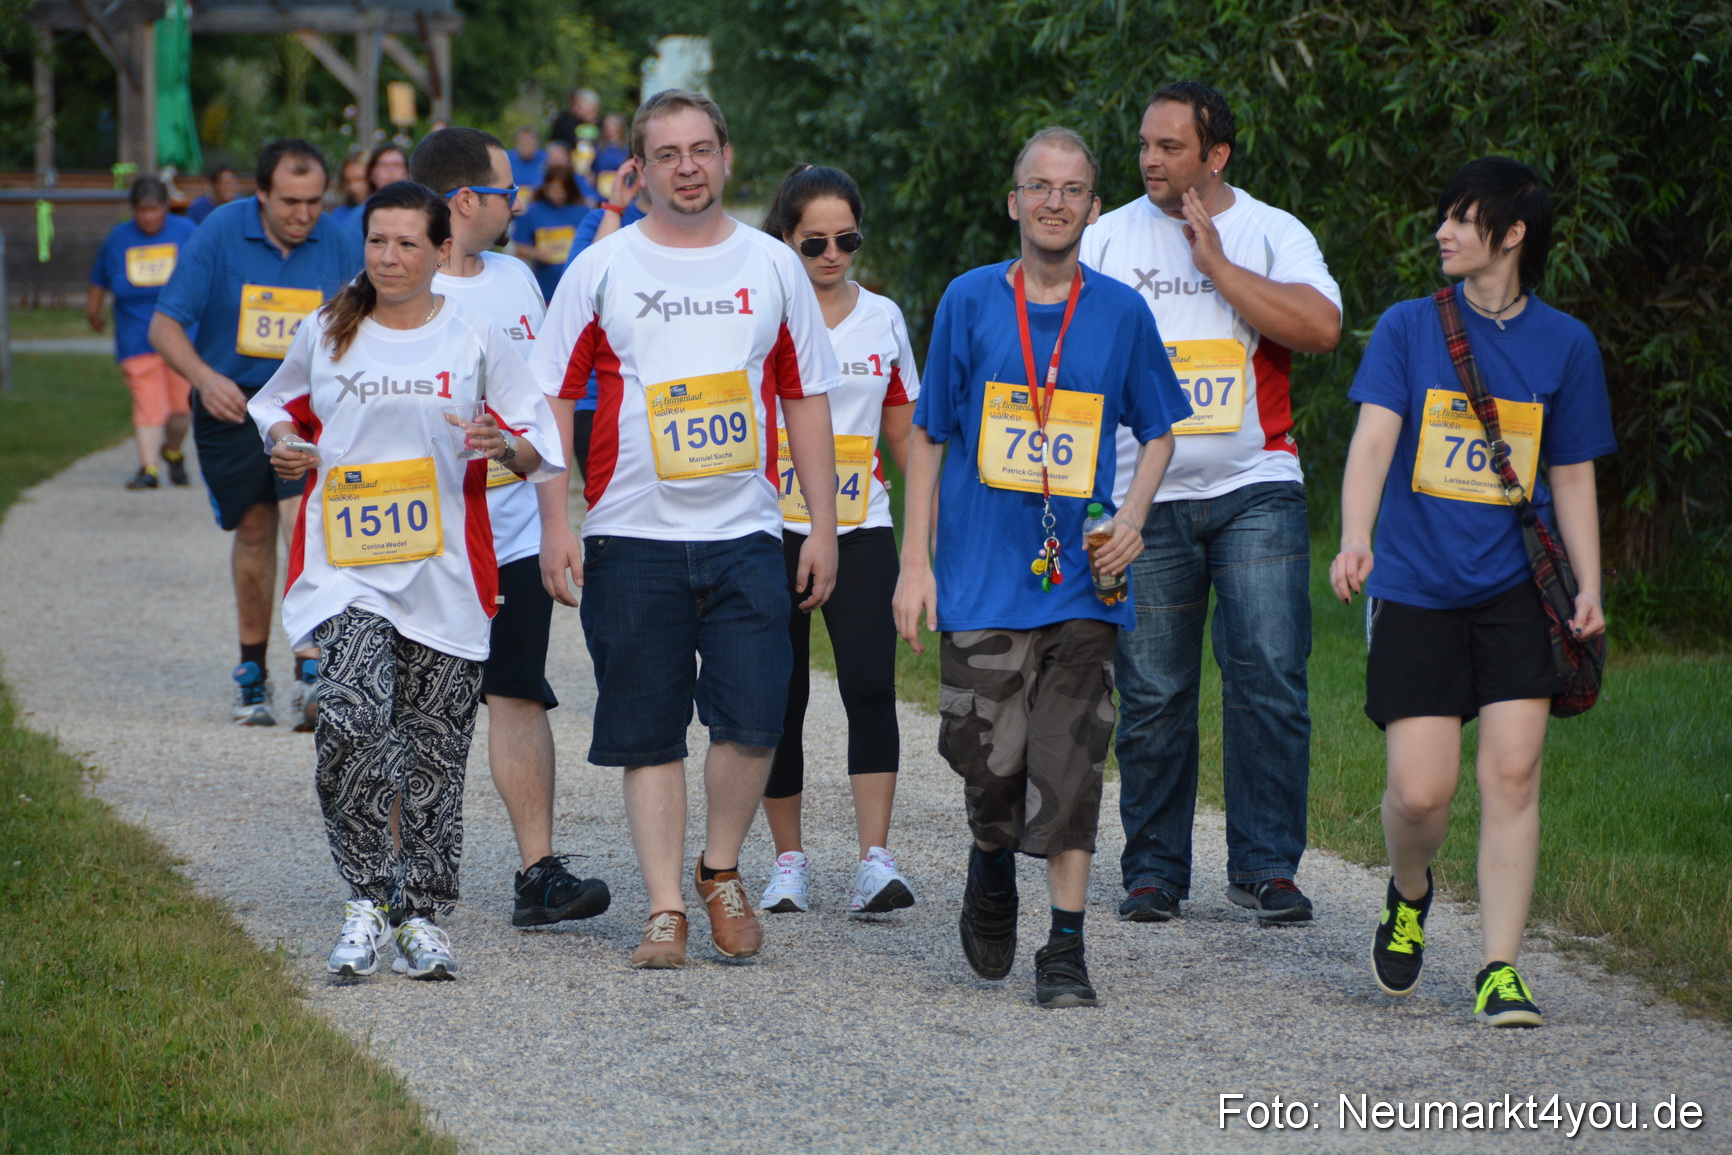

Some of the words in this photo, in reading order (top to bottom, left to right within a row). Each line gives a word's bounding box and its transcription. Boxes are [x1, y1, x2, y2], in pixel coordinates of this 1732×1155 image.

[1132, 268, 1217, 300] Xplus
[633, 287, 753, 322] Xplus1
[334, 370, 452, 404] Xplus1
[663, 411, 747, 452] 1509
[1005, 427, 1074, 466] 796
[689, 454, 713, 463] Manuel
[713, 452, 733, 460] Sachs
[1002, 466, 1026, 475] Patrick
[338, 480, 378, 490] firmenlauf
[1444, 476, 1470, 485] Larissa
[336, 500, 428, 538] 1510
[385, 540, 407, 548] Wedel
